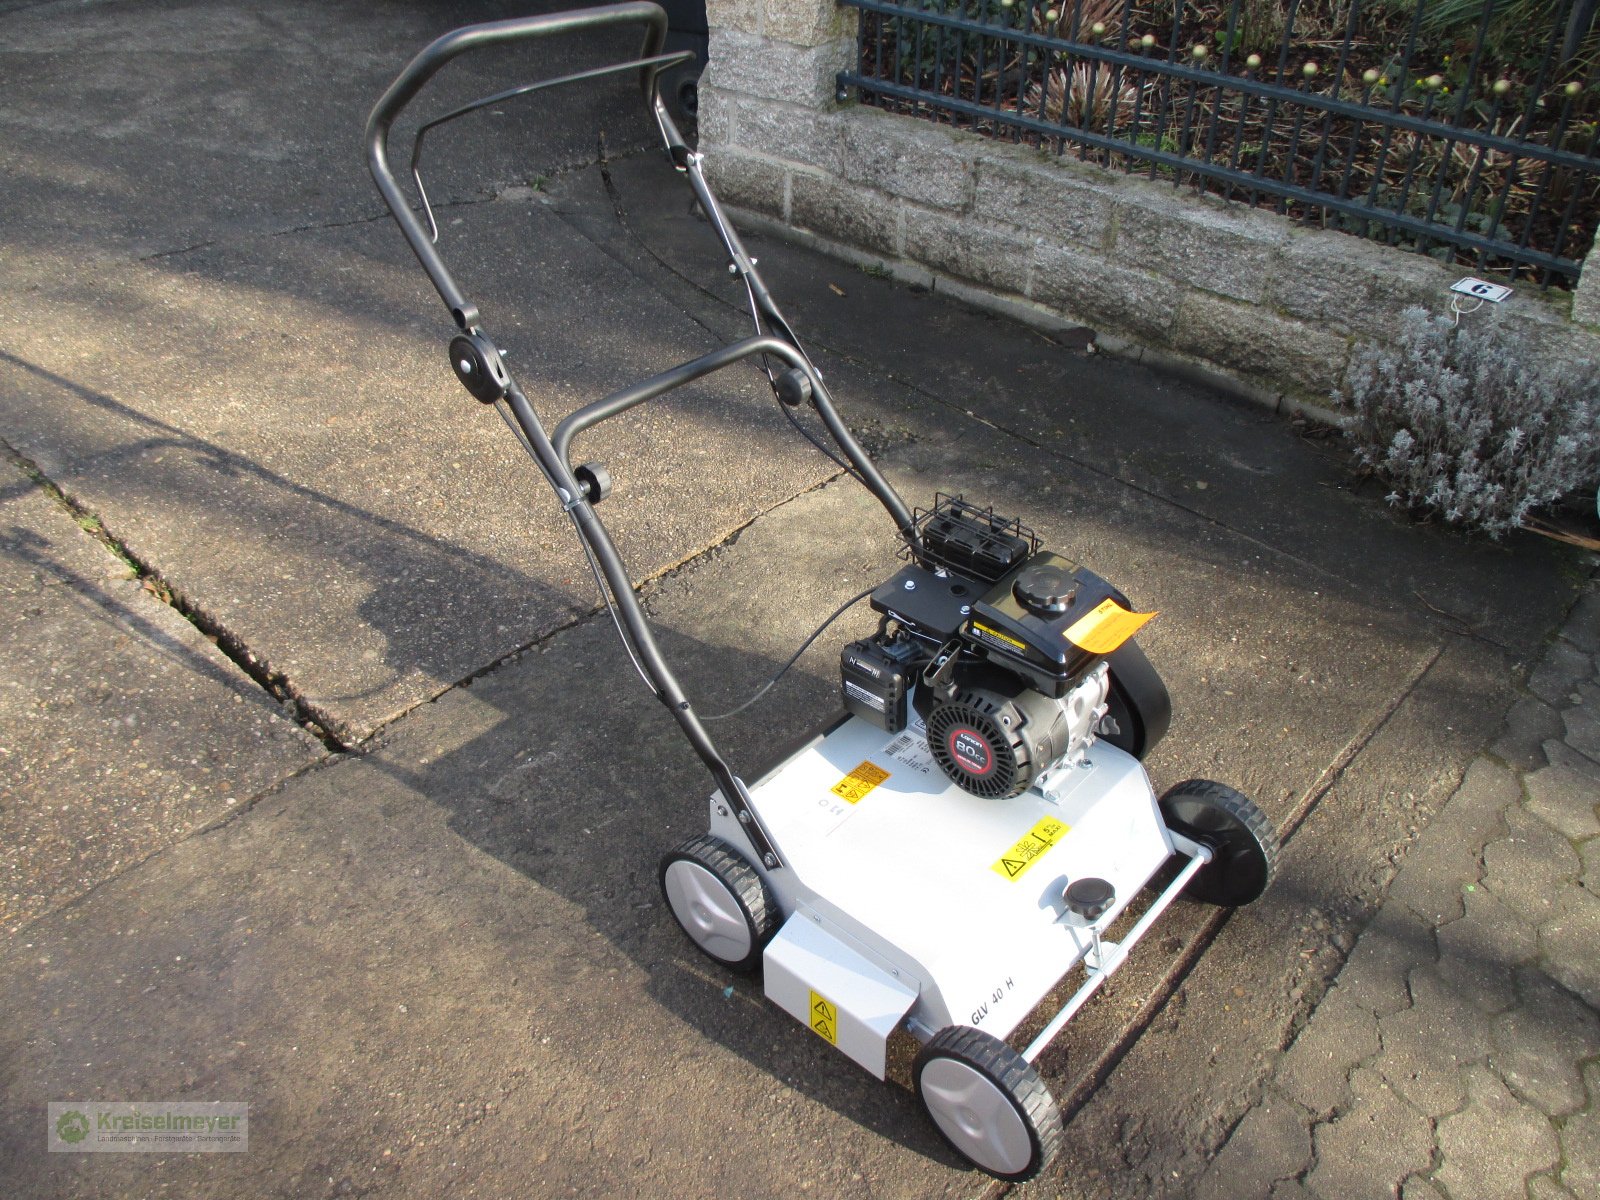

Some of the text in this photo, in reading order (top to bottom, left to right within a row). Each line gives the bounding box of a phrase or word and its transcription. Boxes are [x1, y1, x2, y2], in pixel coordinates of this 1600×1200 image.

[971, 976, 1015, 1026] GLV 40 H
